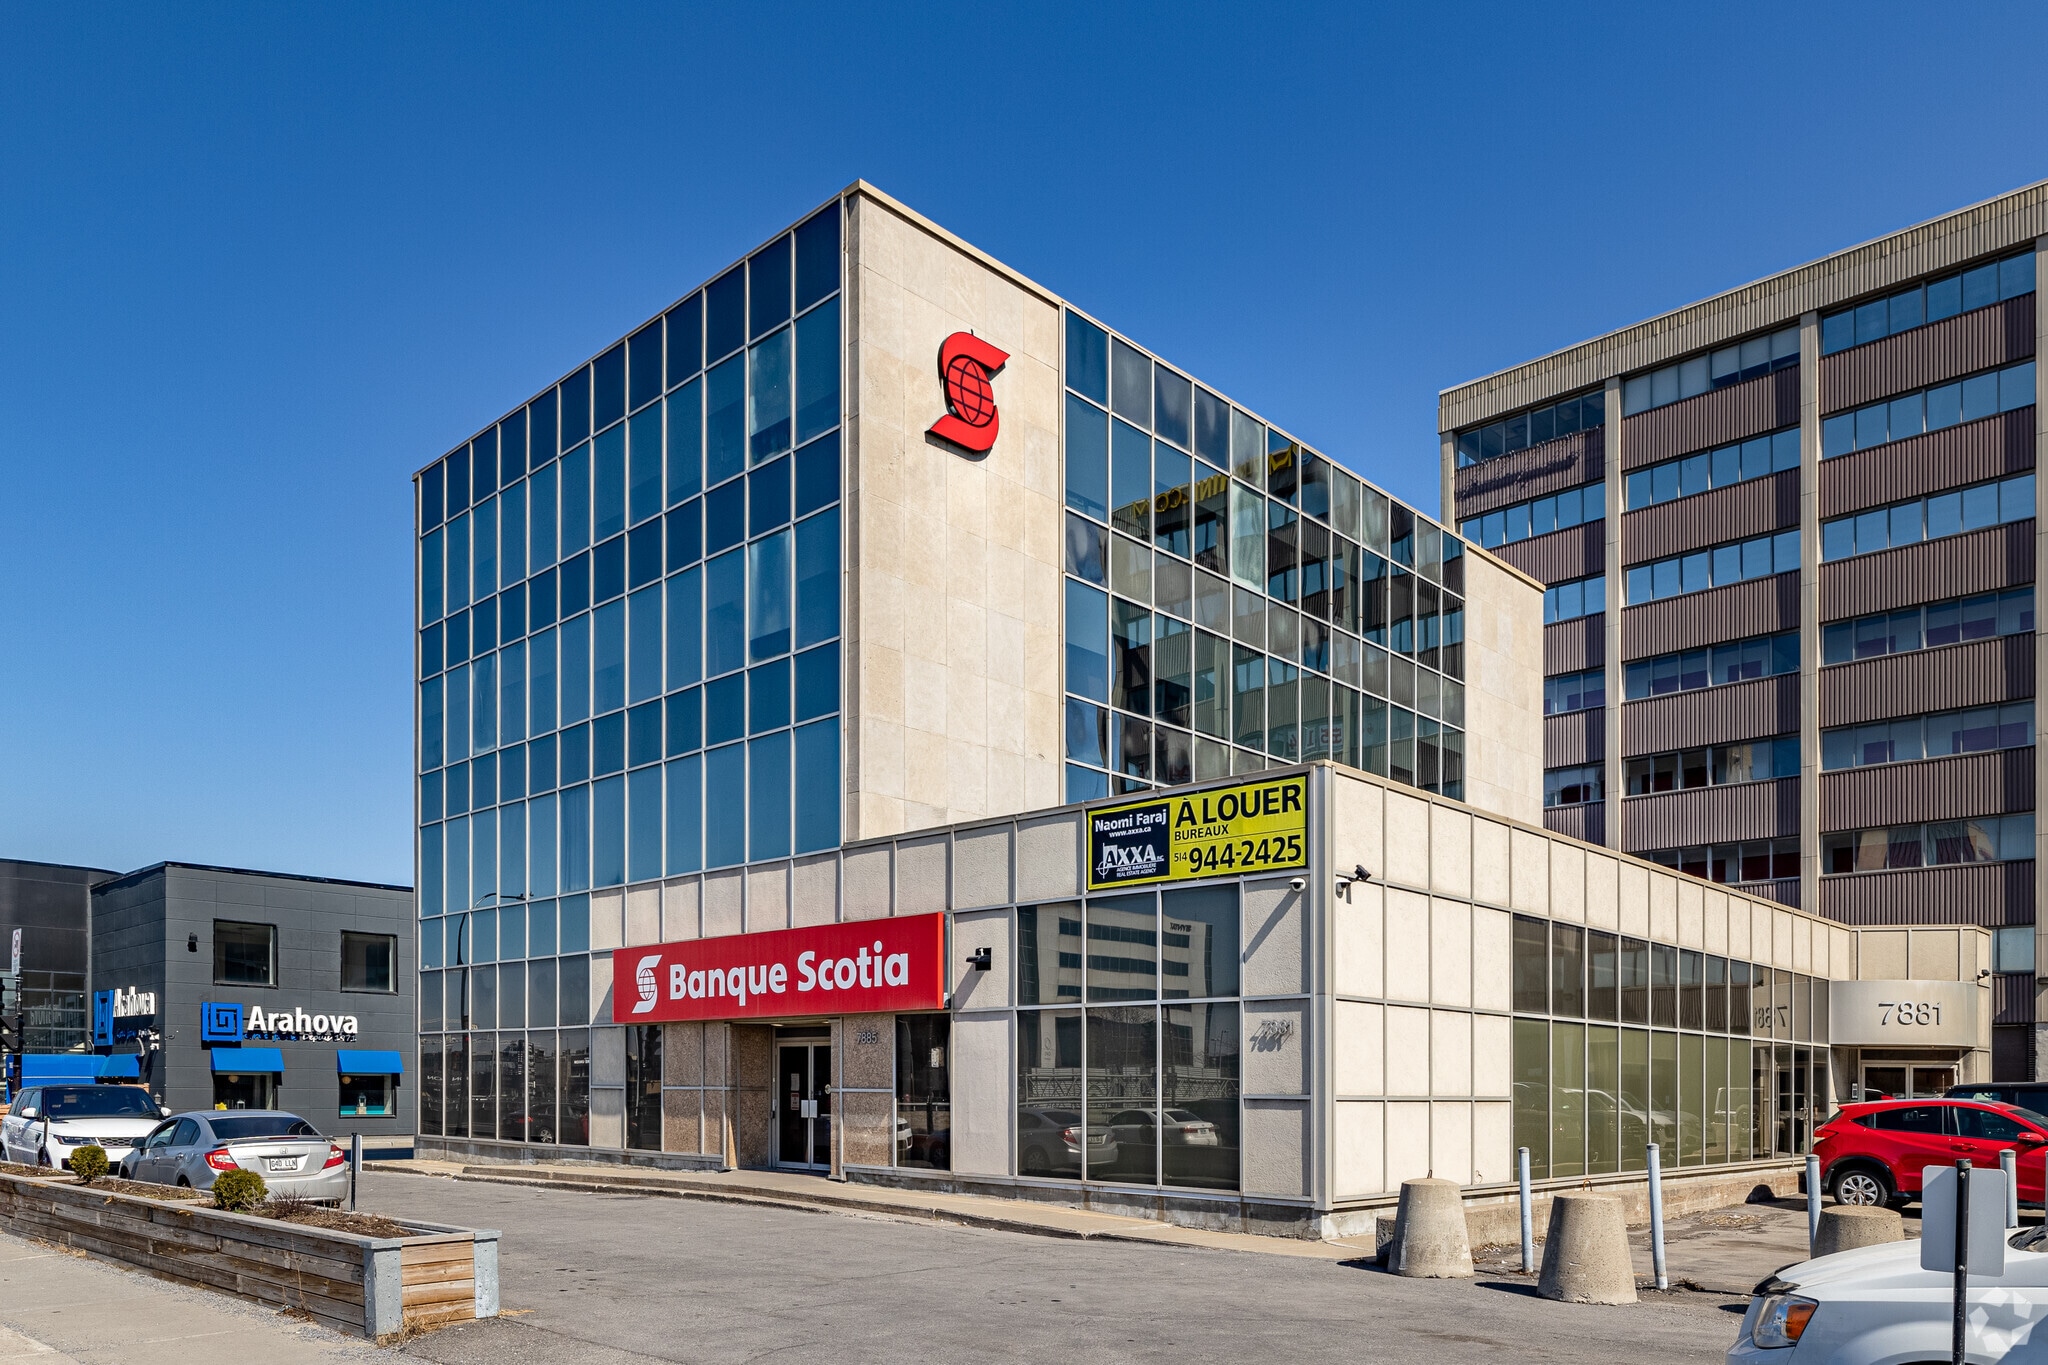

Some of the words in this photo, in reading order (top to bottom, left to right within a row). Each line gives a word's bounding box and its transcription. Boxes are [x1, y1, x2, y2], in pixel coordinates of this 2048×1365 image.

[1175, 798, 1197, 828] À
[1203, 784, 1302, 824] LOUER
[1095, 814, 1133, 832] Naomi
[1136, 809, 1167, 826] Faraj
[1108, 826, 1151, 838] www.axxa.ca
[1175, 824, 1229, 841] BUREAUX
[1174, 851, 1188, 862] 514
[1189, 834, 1302, 873] 944-2425
[669, 961, 788, 1007] Banque
[797, 940, 909, 992] Scotia
[247, 1005, 358, 1034] Arahova
[1878, 1000, 1943, 1026] 7881
[856, 1032, 879, 1045] 7885
